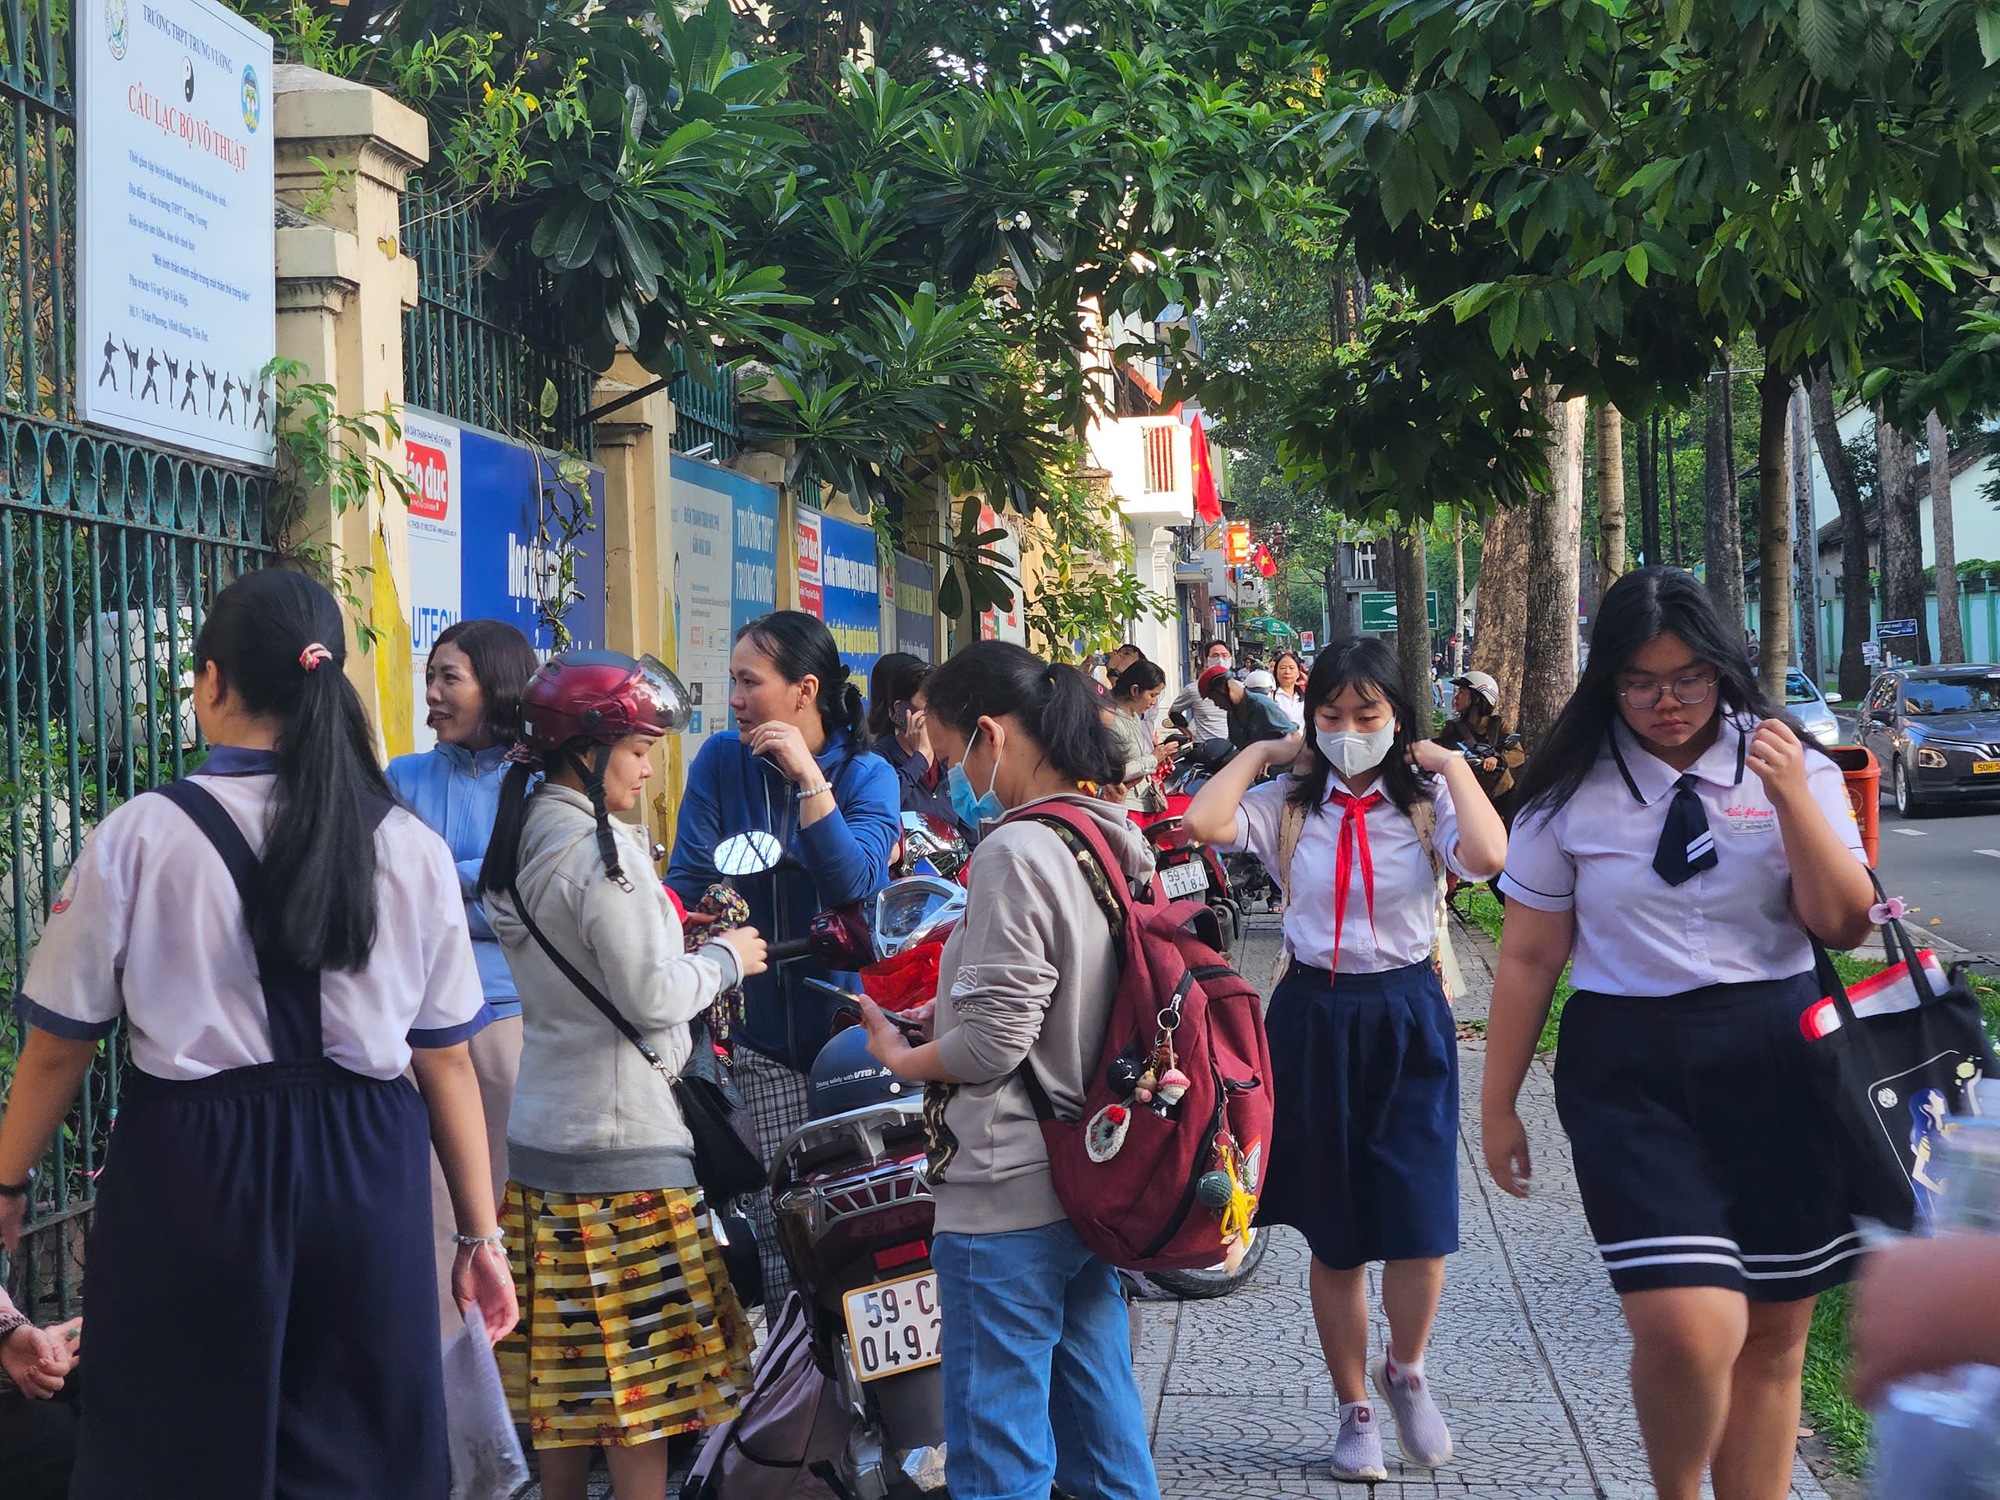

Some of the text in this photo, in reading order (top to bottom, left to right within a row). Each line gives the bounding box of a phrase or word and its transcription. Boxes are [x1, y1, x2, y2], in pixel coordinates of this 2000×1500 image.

[172, 21, 189, 47] THPT
[128, 81, 247, 174] CÂU LẠC BỘ VÕ THUẬT
[508, 532, 527, 613] Học
[1166, 877, 1205, 896] 111.84
[1167, 865, 1199, 883] 59-V2
[815, 1080, 830, 1089] Driving
[829, 1076, 843, 1085] safely
[843, 1073, 854, 1081] with
[863, 1276, 941, 1328] 59-C
